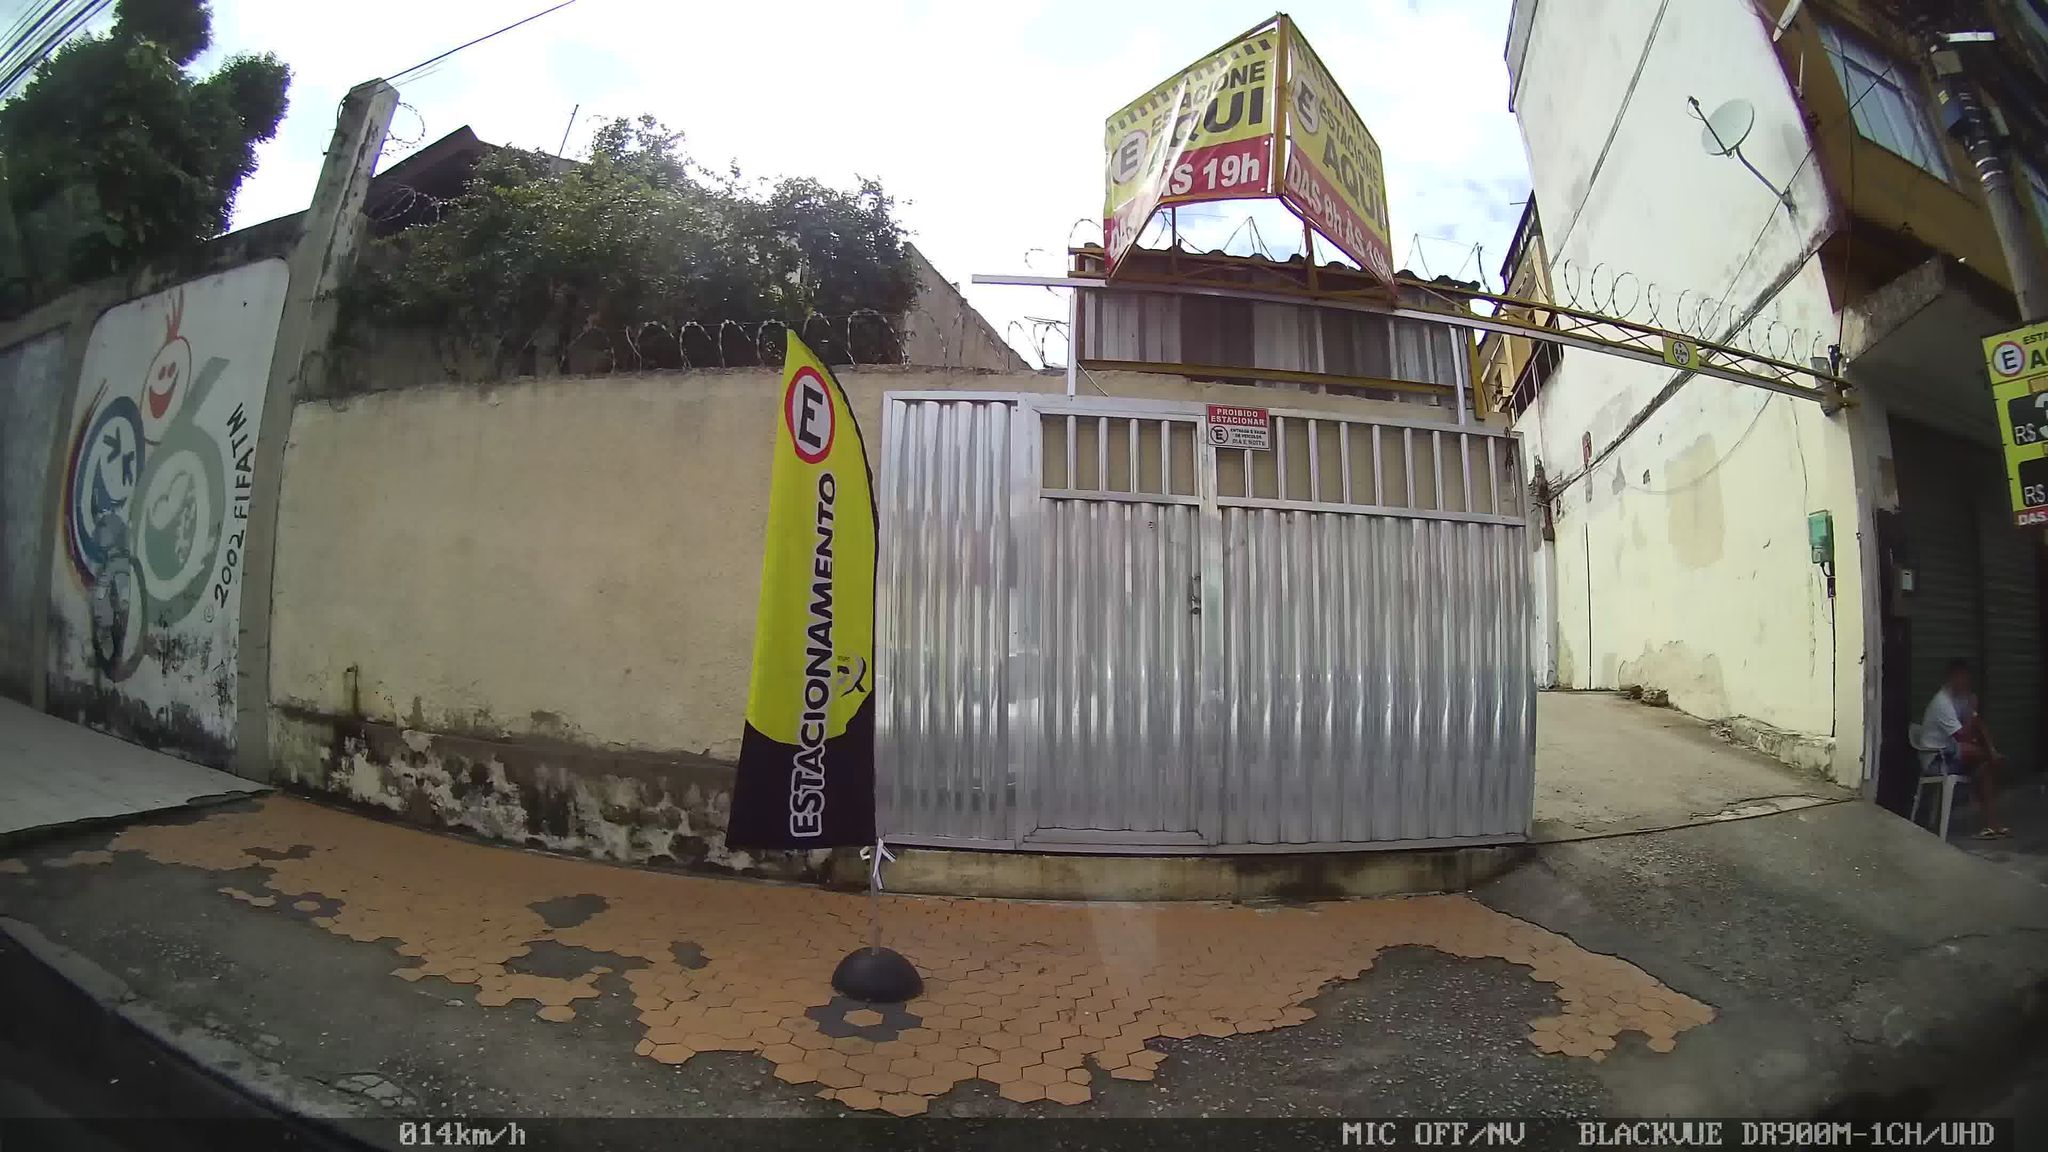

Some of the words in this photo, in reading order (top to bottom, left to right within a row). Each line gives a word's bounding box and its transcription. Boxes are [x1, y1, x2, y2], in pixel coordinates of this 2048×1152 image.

[1203, 153, 1260, 190] 19h
[1320, 97, 1379, 185] ESTACIONE
[1323, 132, 1389, 231] AQUI
[1289, 155, 1322, 216] DAS
[1323, 198, 1344, 239] 8h
[1210, 415, 1266, 427] ESTACIONAR
[1216, 408, 1259, 418] PROIBIDO
[214, 529, 245, 609] 2002
[790, 471, 837, 839] ESTACIONAMENTO
